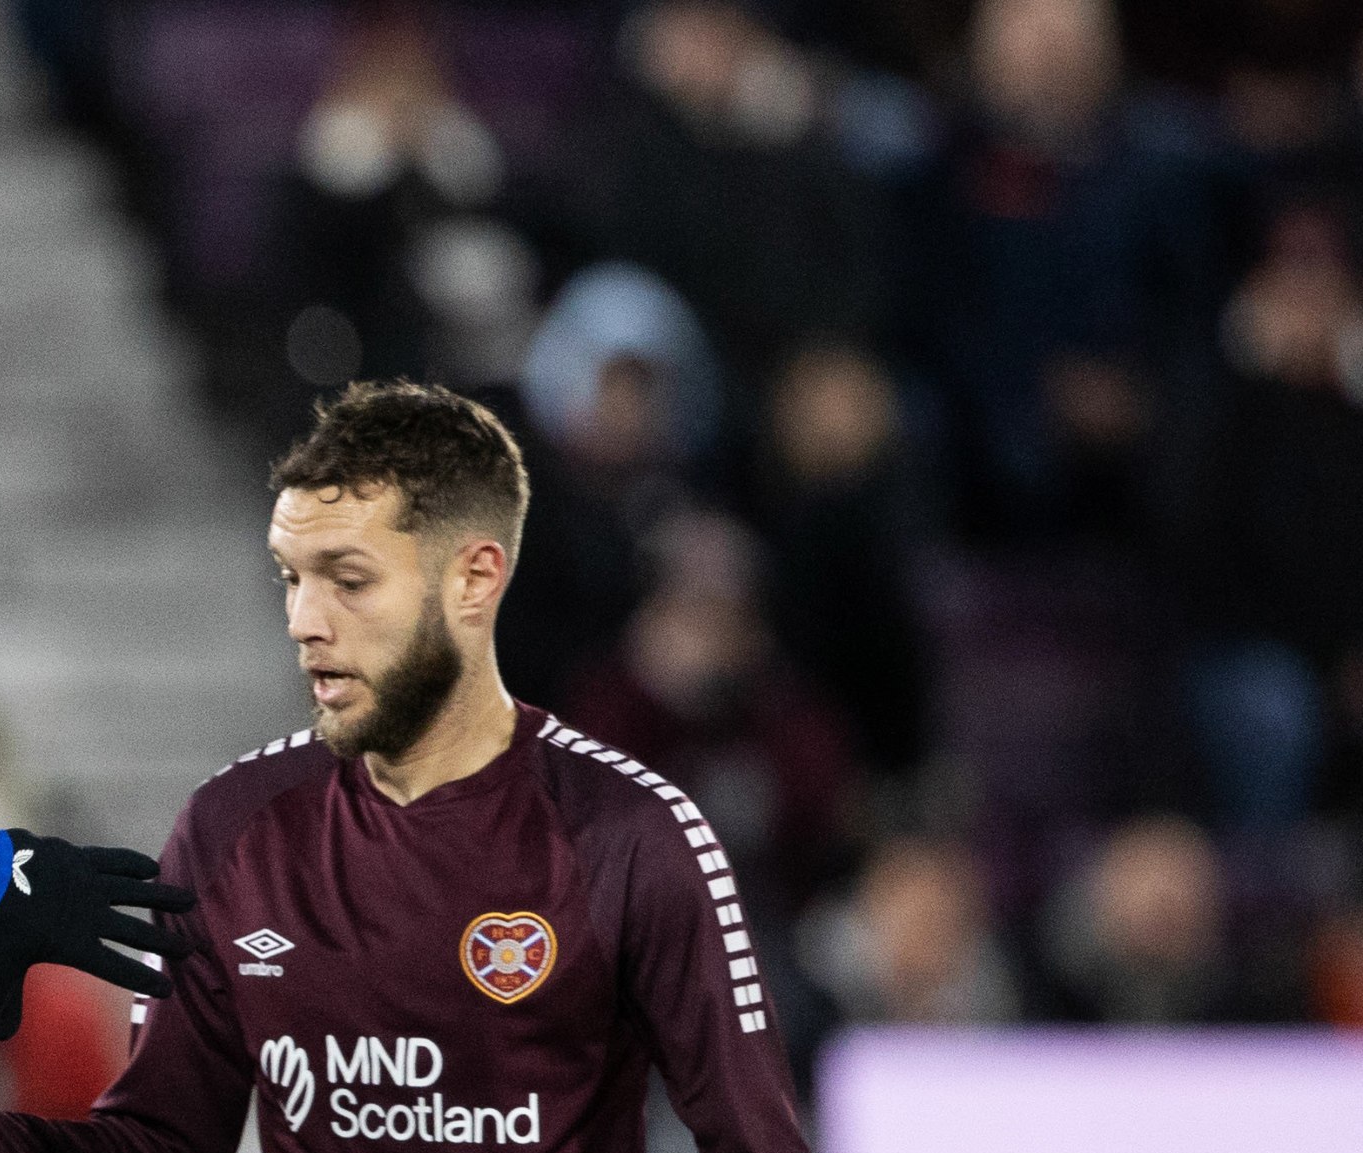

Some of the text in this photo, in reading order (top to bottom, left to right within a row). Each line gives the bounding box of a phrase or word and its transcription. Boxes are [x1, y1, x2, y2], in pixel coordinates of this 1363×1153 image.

[238, 961, 284, 977] umbro
[325, 1034, 444, 1087] MND
[330, 1088, 541, 1144] Scotland
